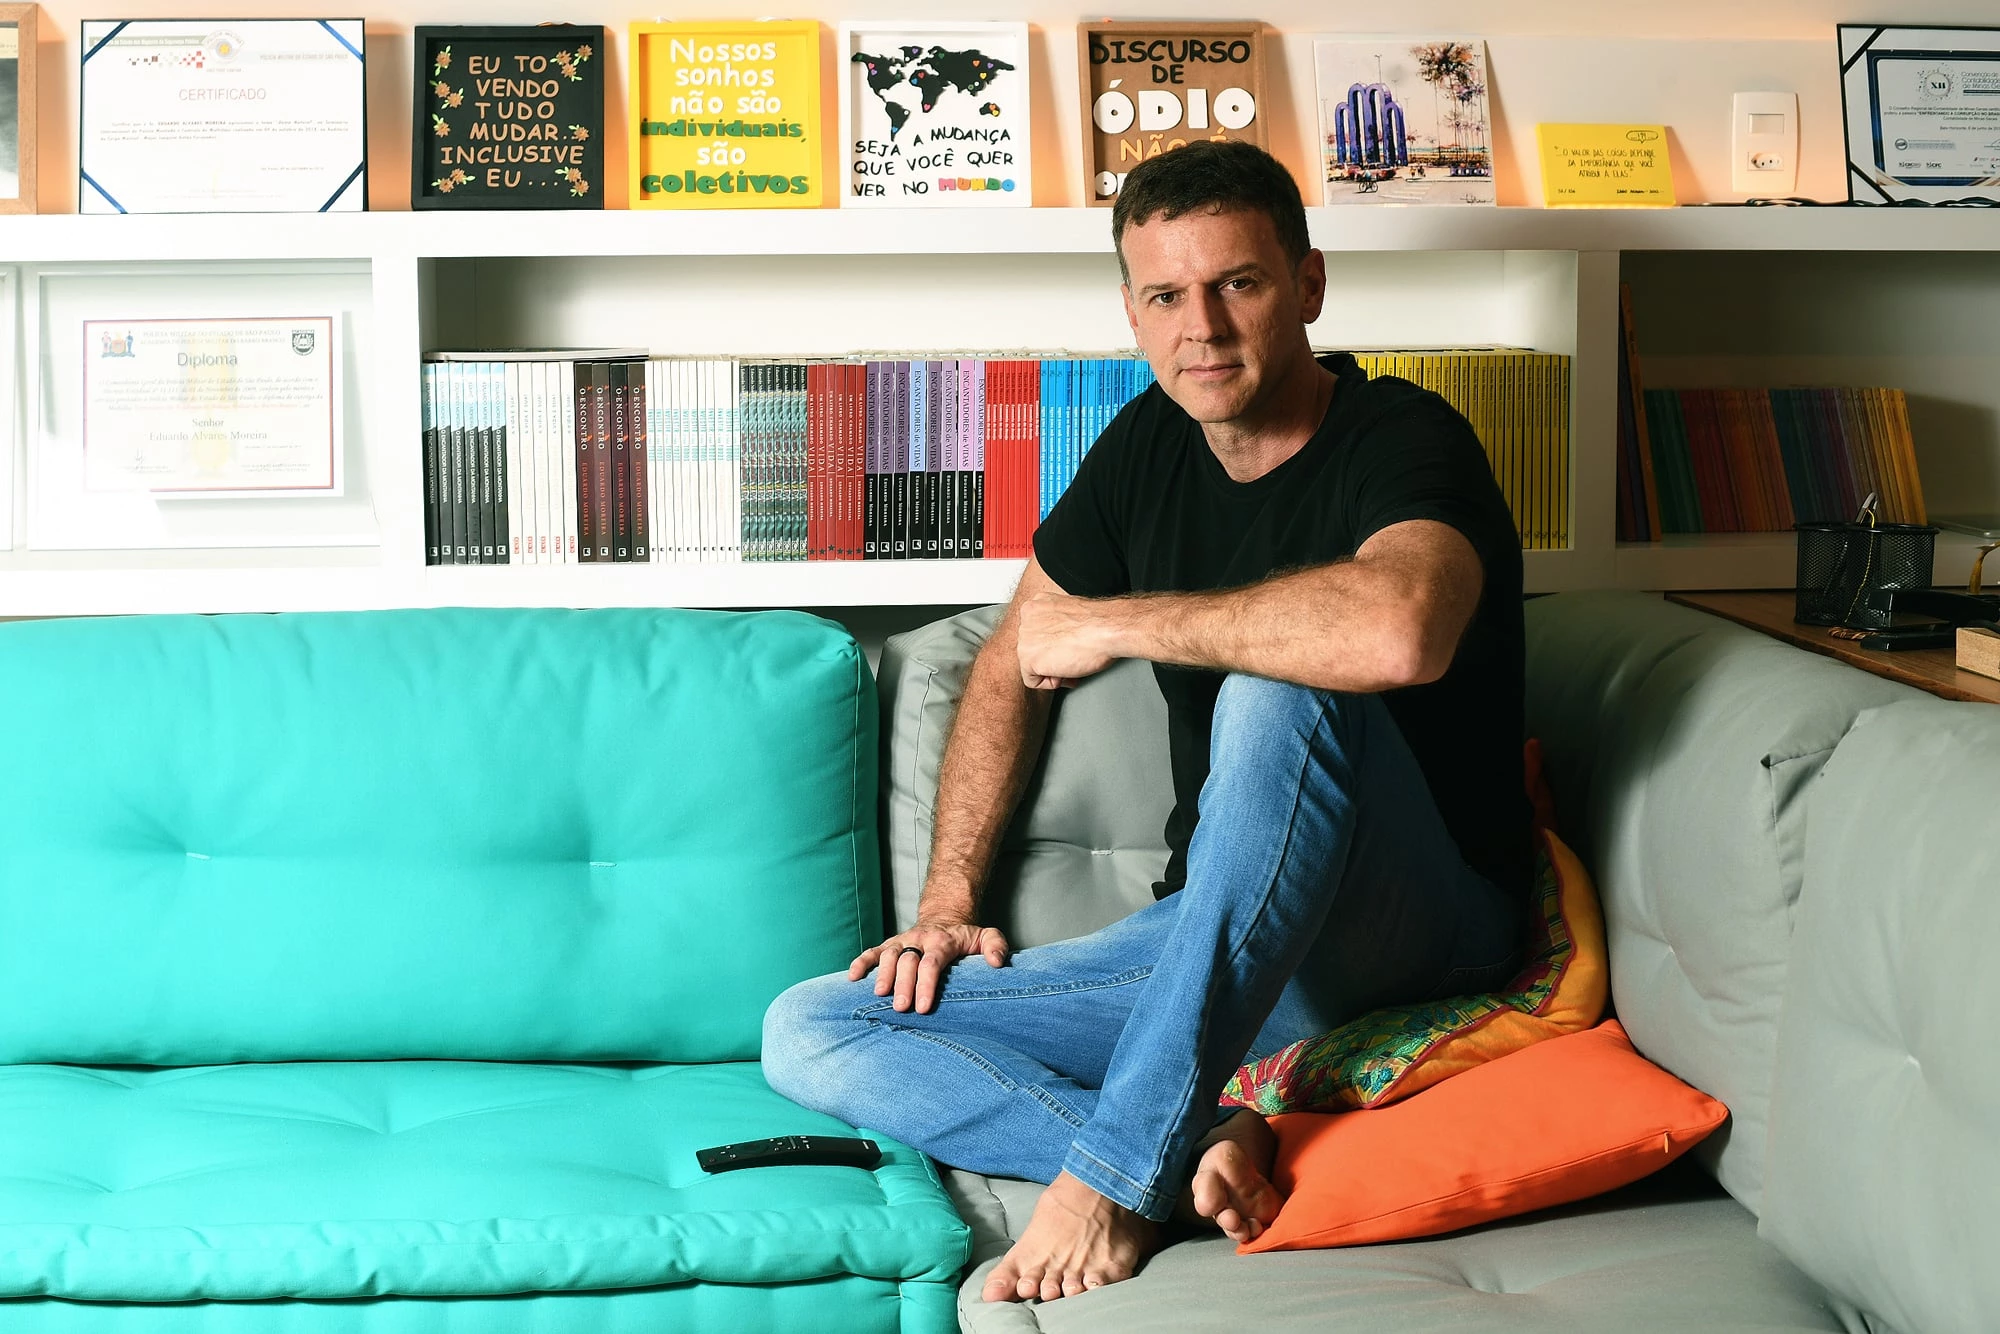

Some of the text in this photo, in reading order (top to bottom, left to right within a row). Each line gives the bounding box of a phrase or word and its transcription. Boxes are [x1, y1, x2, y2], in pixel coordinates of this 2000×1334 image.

[670, 38, 777, 64] Nossos
[1090, 40, 1250, 64] DISCURSO
[468, 56, 546, 74] EU TO
[676, 62, 775, 88] sonhos
[1152, 64, 1184, 84] DE
[179, 88, 266, 100] CERTIFICADO
[476, 78, 560, 98] VENDO
[474, 101, 556, 120] TUDO
[670, 89, 782, 114] não são
[1093, 78, 1256, 134] ÓDIO
[642, 118, 806, 143] individuais,
[855, 126, 1010, 156] SEJA A MUDANÇA
[440, 145, 584, 165] INCLUSIVE
[696, 141, 746, 166] são
[854, 148, 1013, 176] QUE VOCÊ QUER
[1593, 149, 1604, 157] DAS
[1607, 148, 1627, 156] COISAS
[642, 170, 809, 194] coletivos
[854, 178, 1015, 196] VER NO MUNDO
[177, 352, 238, 369] Diploma
[192, 418, 224, 428] Senhor
[580, 398, 588, 450] ENCONTRO
[596, 396, 604, 450] ENCONTRO
[616, 397, 624, 450] ENCONTRO
[633, 396, 641, 450] ENCONTRO
[149, 431, 266, 442] Eduardo Alvares Moreira
[868, 436, 874, 446] de
[882, 436, 889, 445] de
[898, 436, 904, 444] de
[914, 434, 920, 442] de
[930, 435, 936, 444] de
[946, 434, 952, 442] de
[962, 434, 969, 442] de
[484, 468, 490, 476] DA
